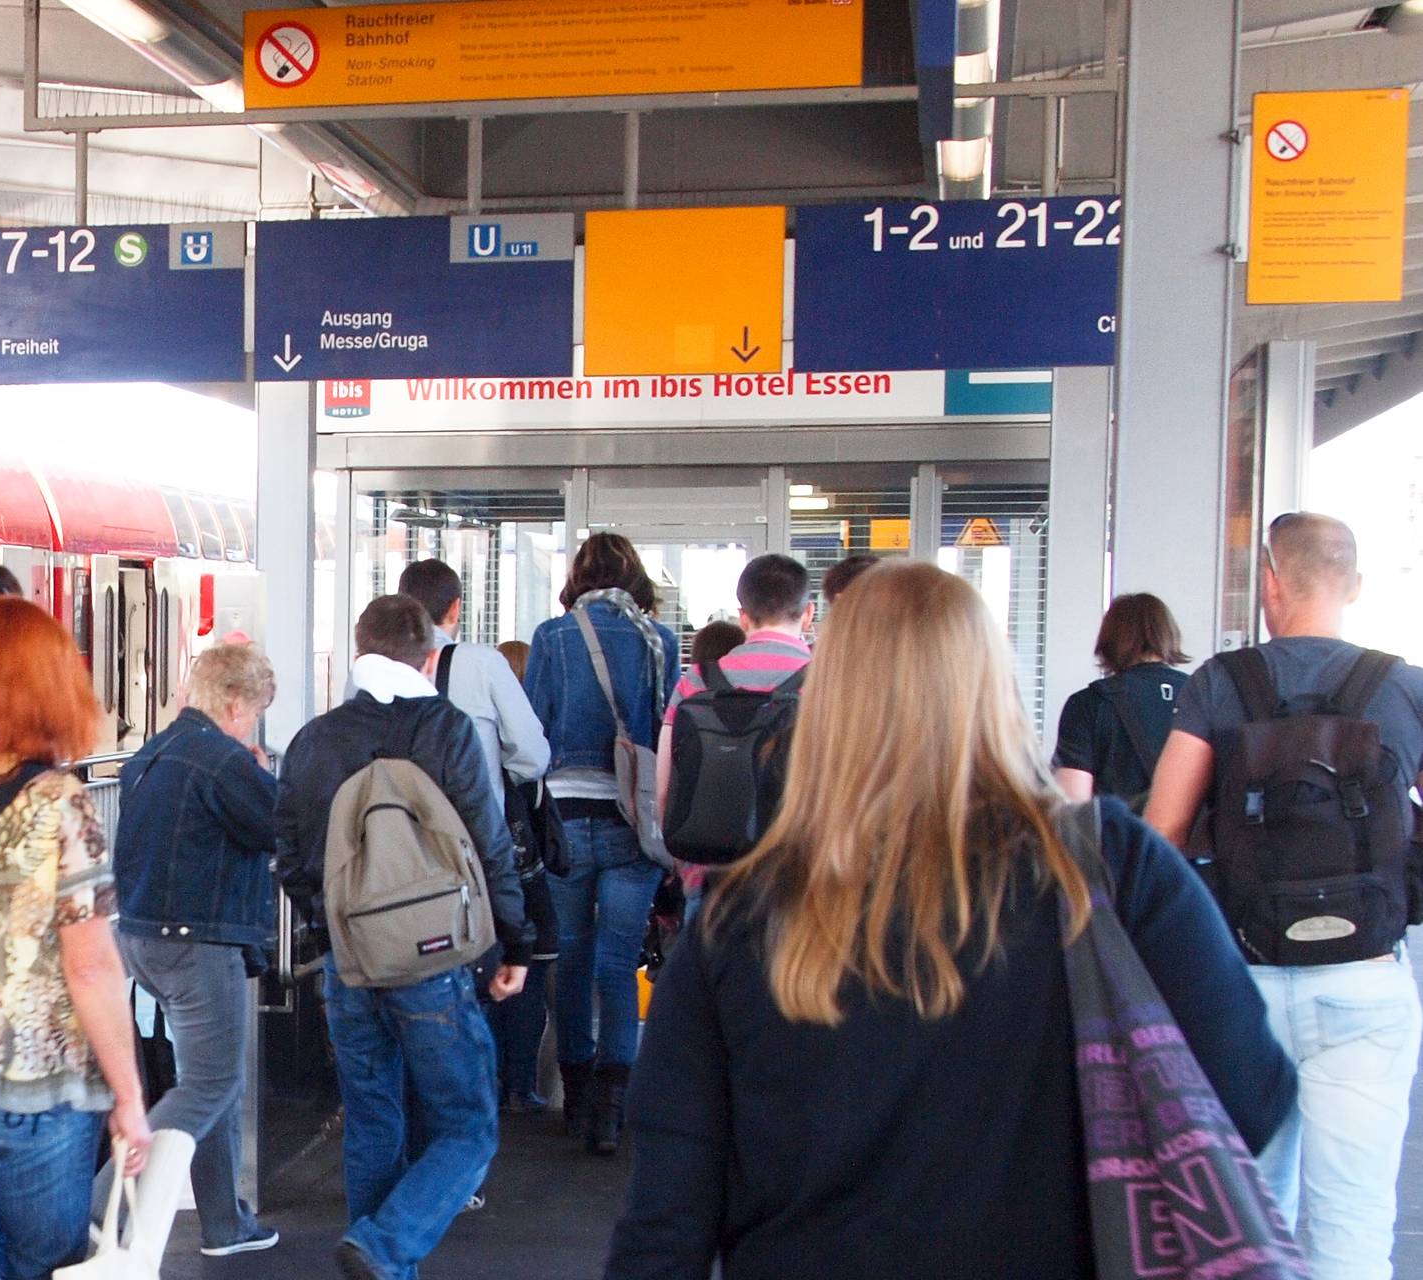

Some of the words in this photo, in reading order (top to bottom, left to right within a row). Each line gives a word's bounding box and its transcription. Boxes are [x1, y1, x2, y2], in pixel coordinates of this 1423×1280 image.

[346, 13, 435, 28] Rauchfreier
[346, 31, 409, 47] Bahnhof
[346, 57, 435, 71] Non-Smoking
[346, 74, 393, 87] Station
[864, 205, 939, 251] 1-2
[949, 232, 983, 249] und
[474, 226, 496, 255] U
[2, 229, 95, 273] 7-12
[118, 234, 143, 265] S
[321, 311, 392, 329] Ausgang
[2, 339, 59, 355] Freiheit
[320, 333, 428, 351] Messe/Gruga
[332, 381, 363, 398] ibis
[406, 376, 592, 401] Willkommen
[604, 376, 639, 398] im
[651, 374, 702, 398] ibis
[713, 368, 794, 396] Hotel
[806, 372, 890, 395] Essen
[332, 408, 364, 416] HOTEL
